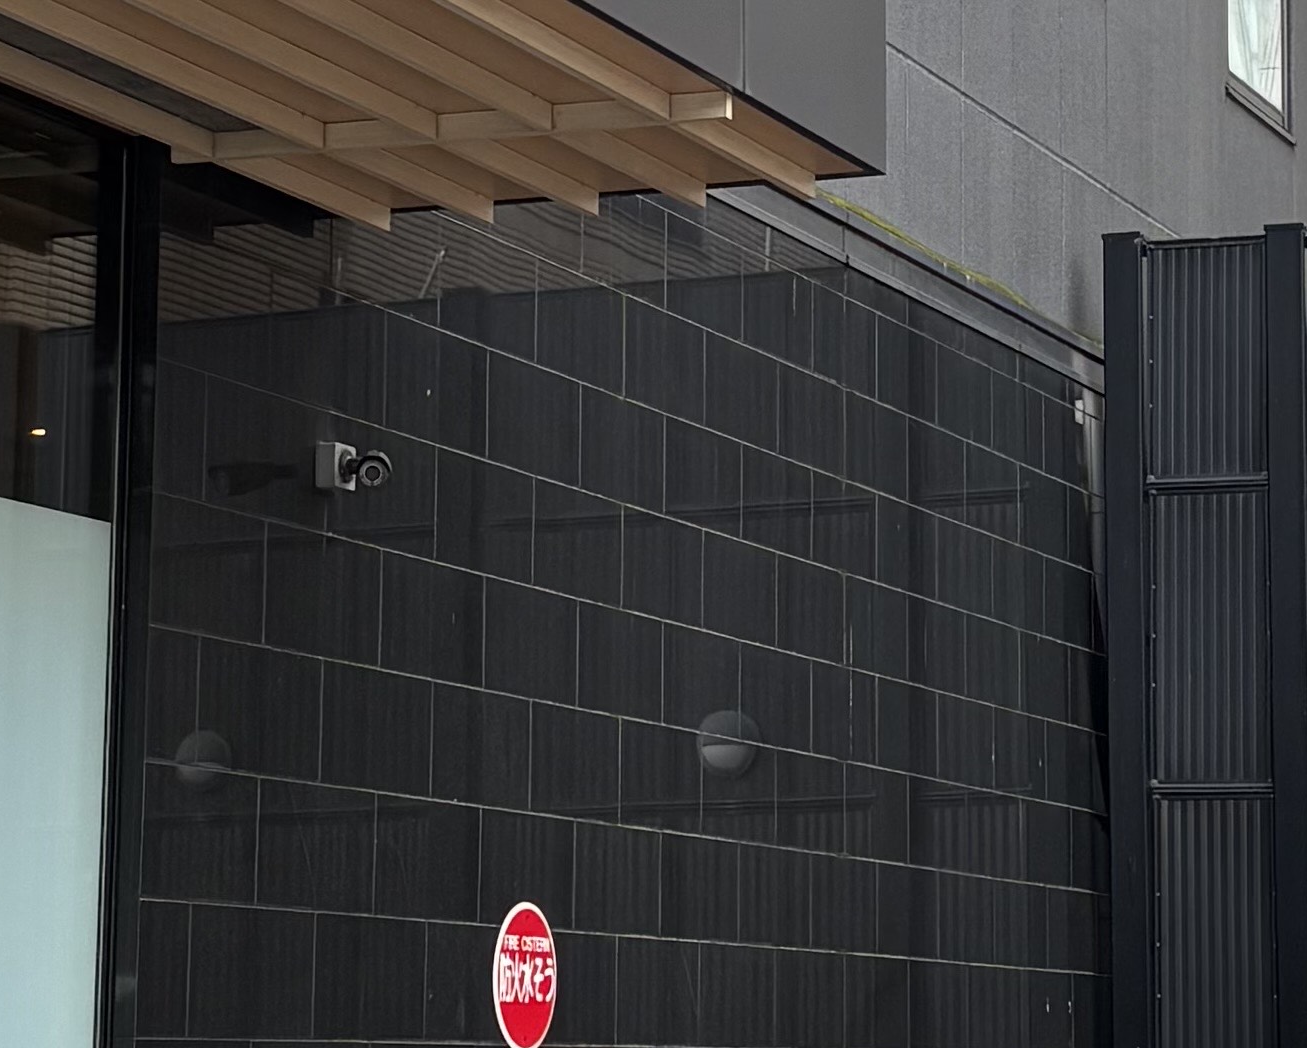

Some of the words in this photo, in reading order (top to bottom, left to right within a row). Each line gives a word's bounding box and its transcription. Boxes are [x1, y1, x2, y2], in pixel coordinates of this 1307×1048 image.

[503, 935, 520, 951] FIRE
[521, 935, 550, 952] CISTERN
[500, 952, 555, 1003] 防火水そう
